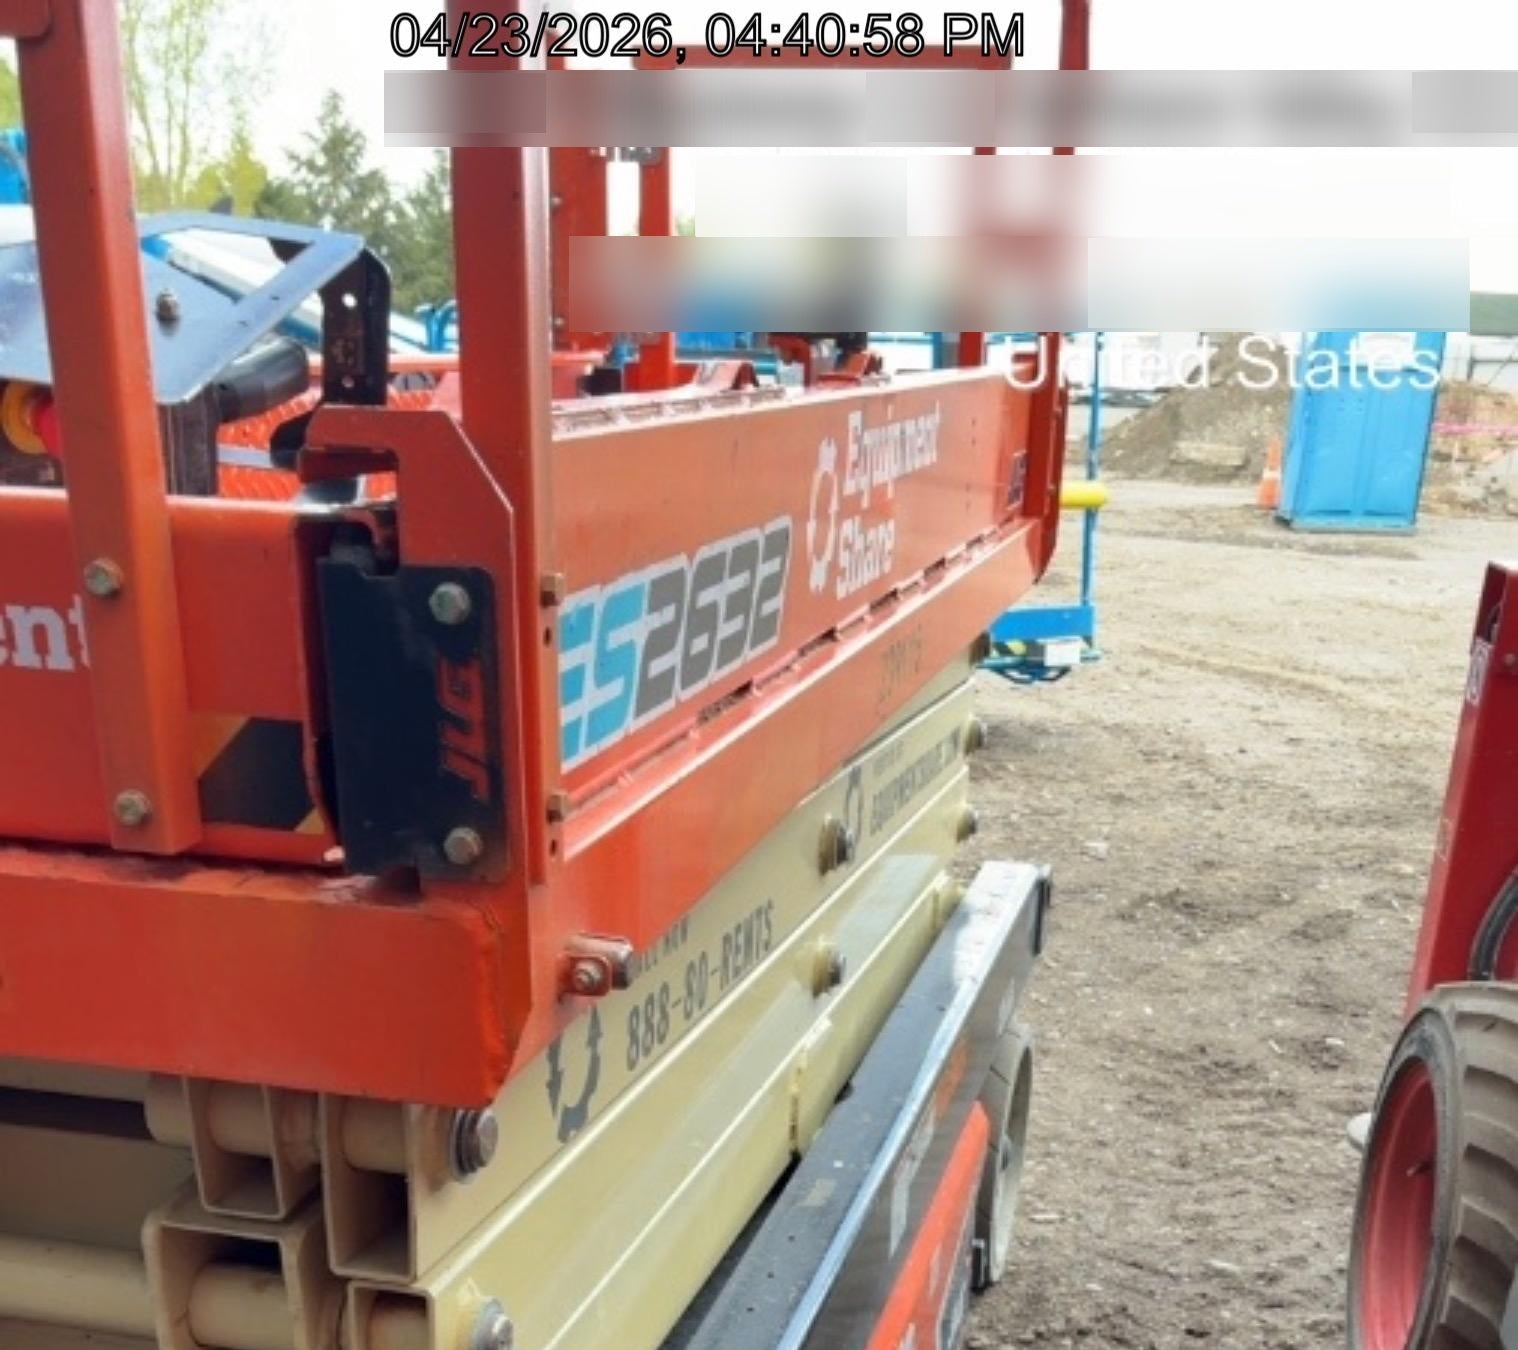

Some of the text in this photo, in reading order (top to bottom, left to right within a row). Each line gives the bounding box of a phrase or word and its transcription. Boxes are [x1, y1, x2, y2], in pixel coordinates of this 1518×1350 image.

[837, 515, 894, 600] Share
[559, 515, 792, 774] ES2632
[436, 655, 490, 800] JLG
